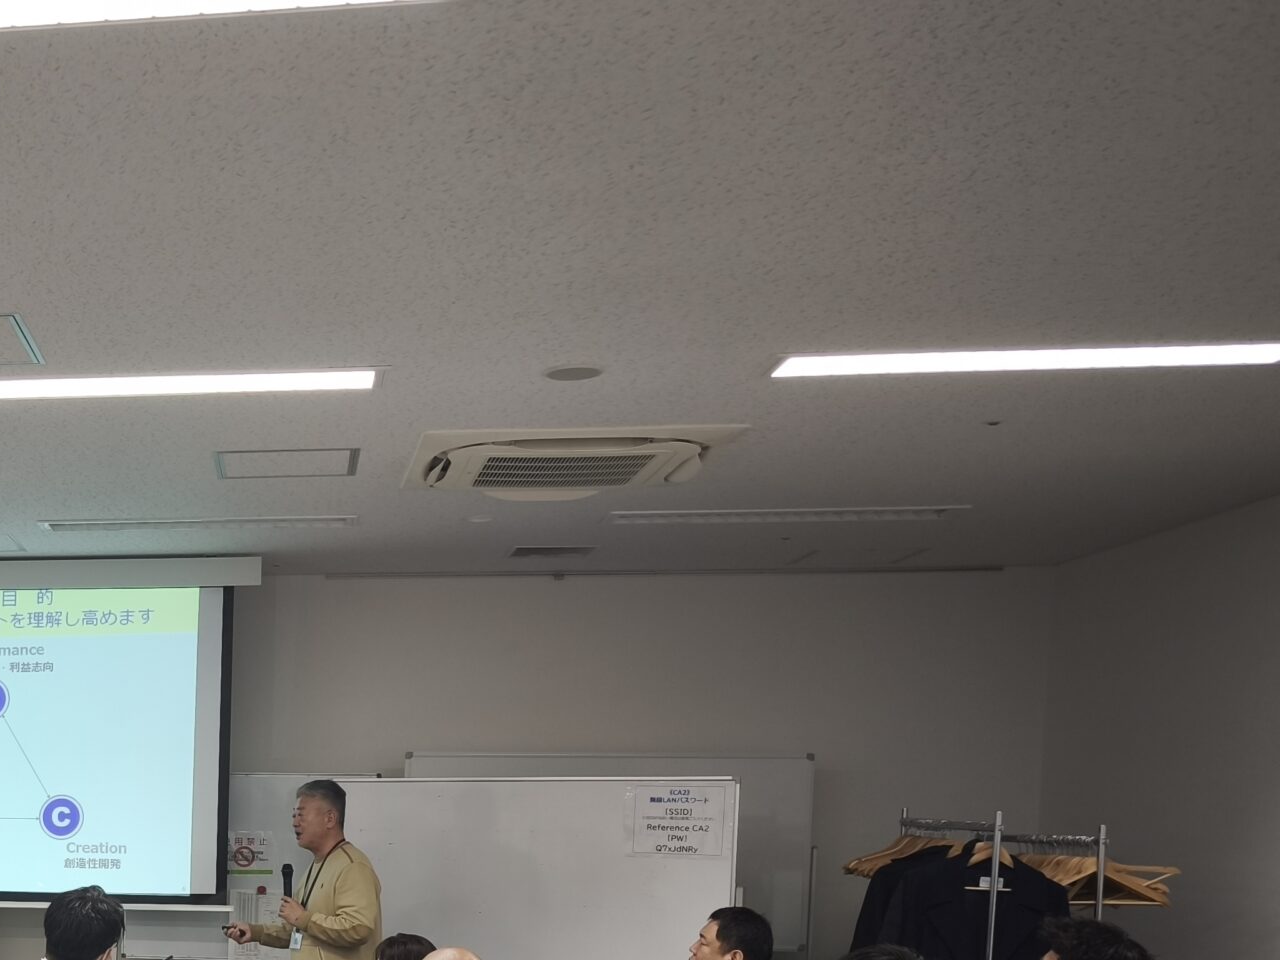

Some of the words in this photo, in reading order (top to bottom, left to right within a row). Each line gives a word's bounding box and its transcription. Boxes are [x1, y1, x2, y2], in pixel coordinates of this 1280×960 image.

[51, 806, 72, 827] C
[646, 823, 690, 832] Reference
[691, 824, 710, 832] CA2
[66, 841, 127, 855] Creation
[63, 857, 121, 870] 創造性開発
